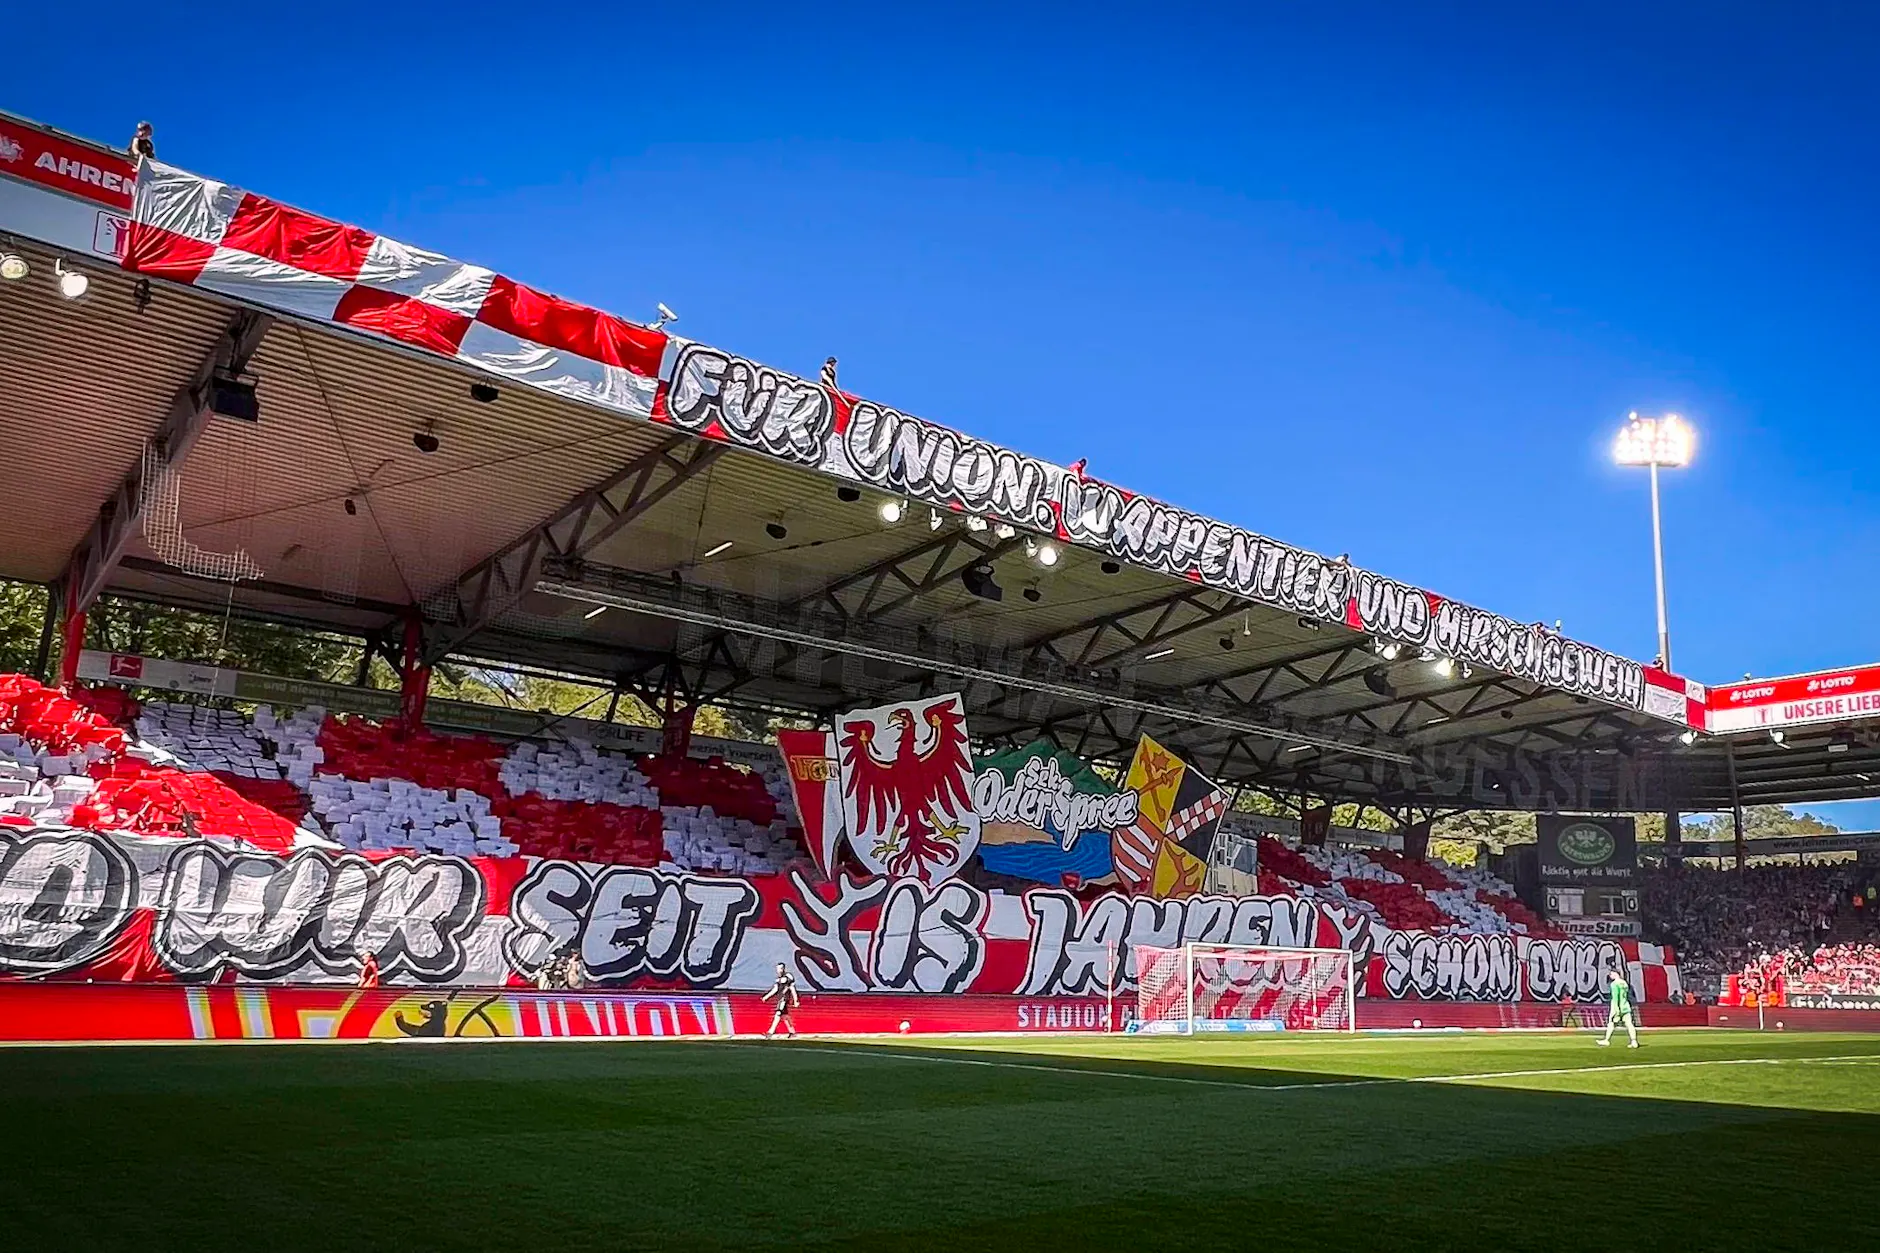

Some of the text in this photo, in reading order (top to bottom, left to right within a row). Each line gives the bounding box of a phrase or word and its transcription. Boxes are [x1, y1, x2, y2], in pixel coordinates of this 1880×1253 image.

[668, 343, 1646, 710] FÜR UNION. WAPPENTIER UND HIRSCHGEWEIH
[1742, 686, 1775, 699] LOTTO
[1820, 675, 1856, 689] LOTTO
[1784, 699, 1844, 719] UNSERE
[152, 838, 486, 982] WIR
[503, 861, 760, 986] SEIT
[1383, 930, 1517, 1001] SCHON
[1017, 1004, 1108, 1029] STADION
